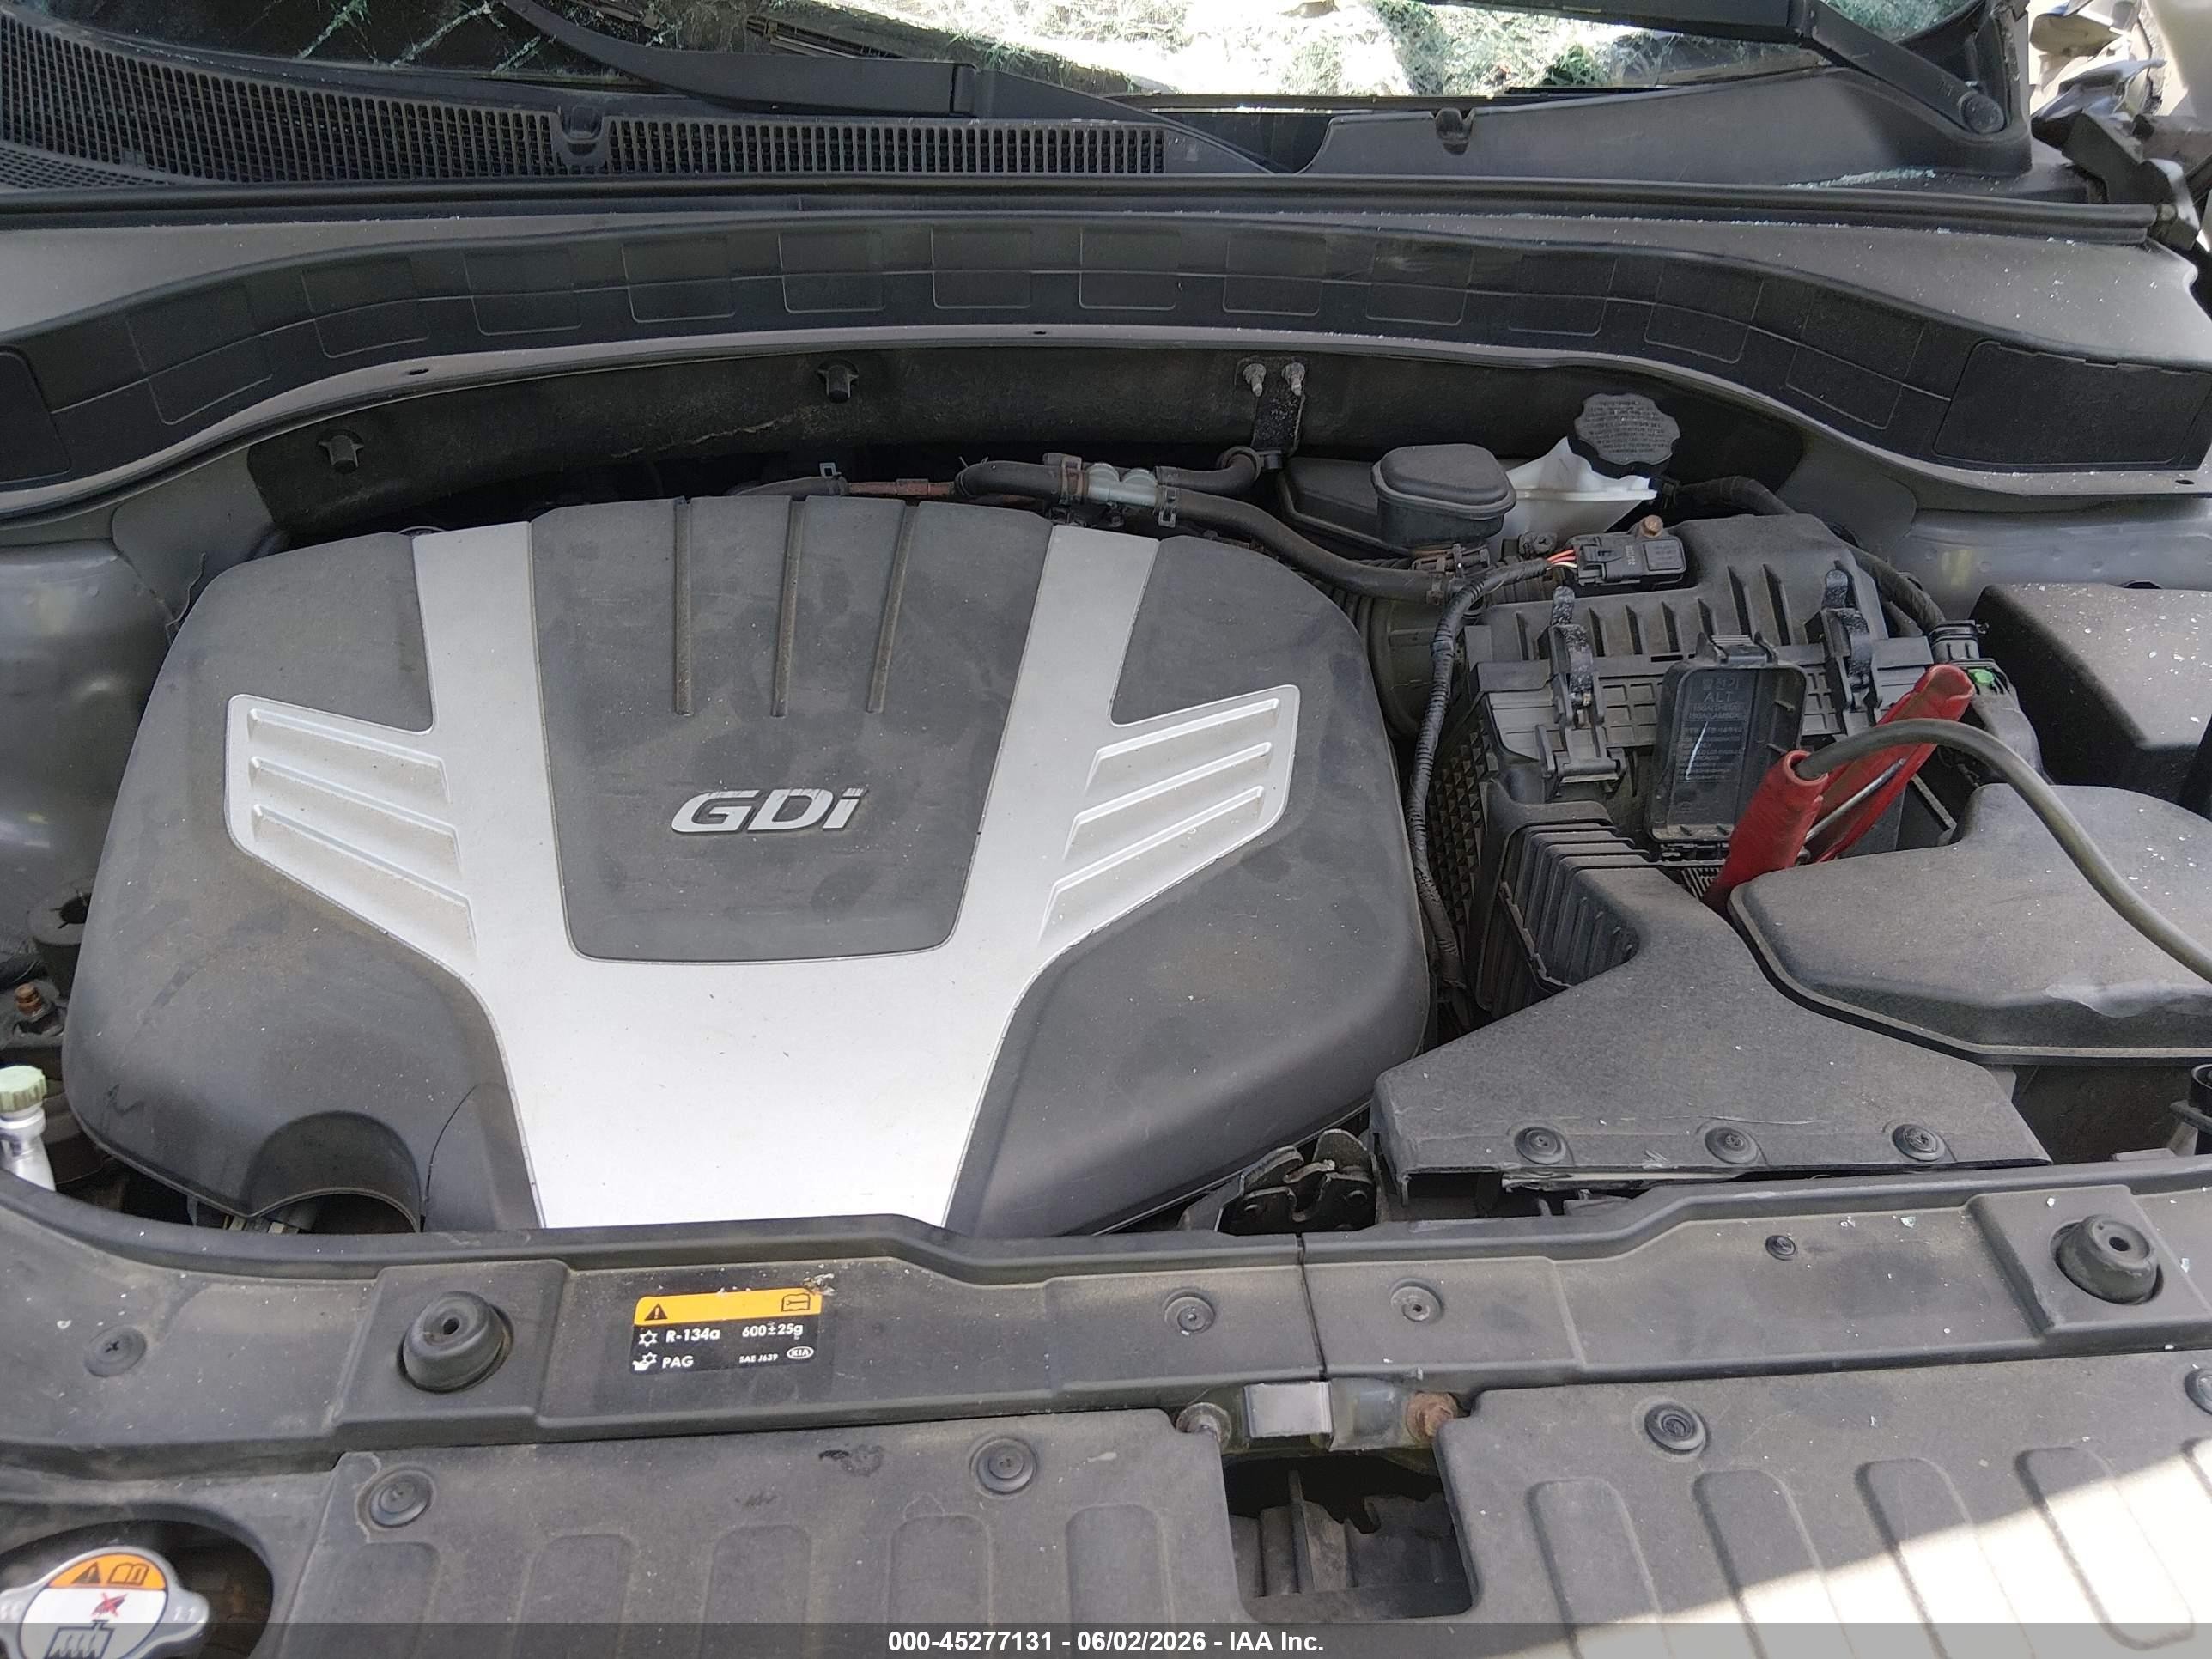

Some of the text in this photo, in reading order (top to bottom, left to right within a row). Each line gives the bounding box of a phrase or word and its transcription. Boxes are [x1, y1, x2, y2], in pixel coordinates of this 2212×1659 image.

[1704, 691, 1733, 702] ALT
[672, 787, 865, 832] GDi
[665, 1323, 804, 1343] R-134a 600±25g
[661, 1353, 779, 1369] PAG SAE J639
